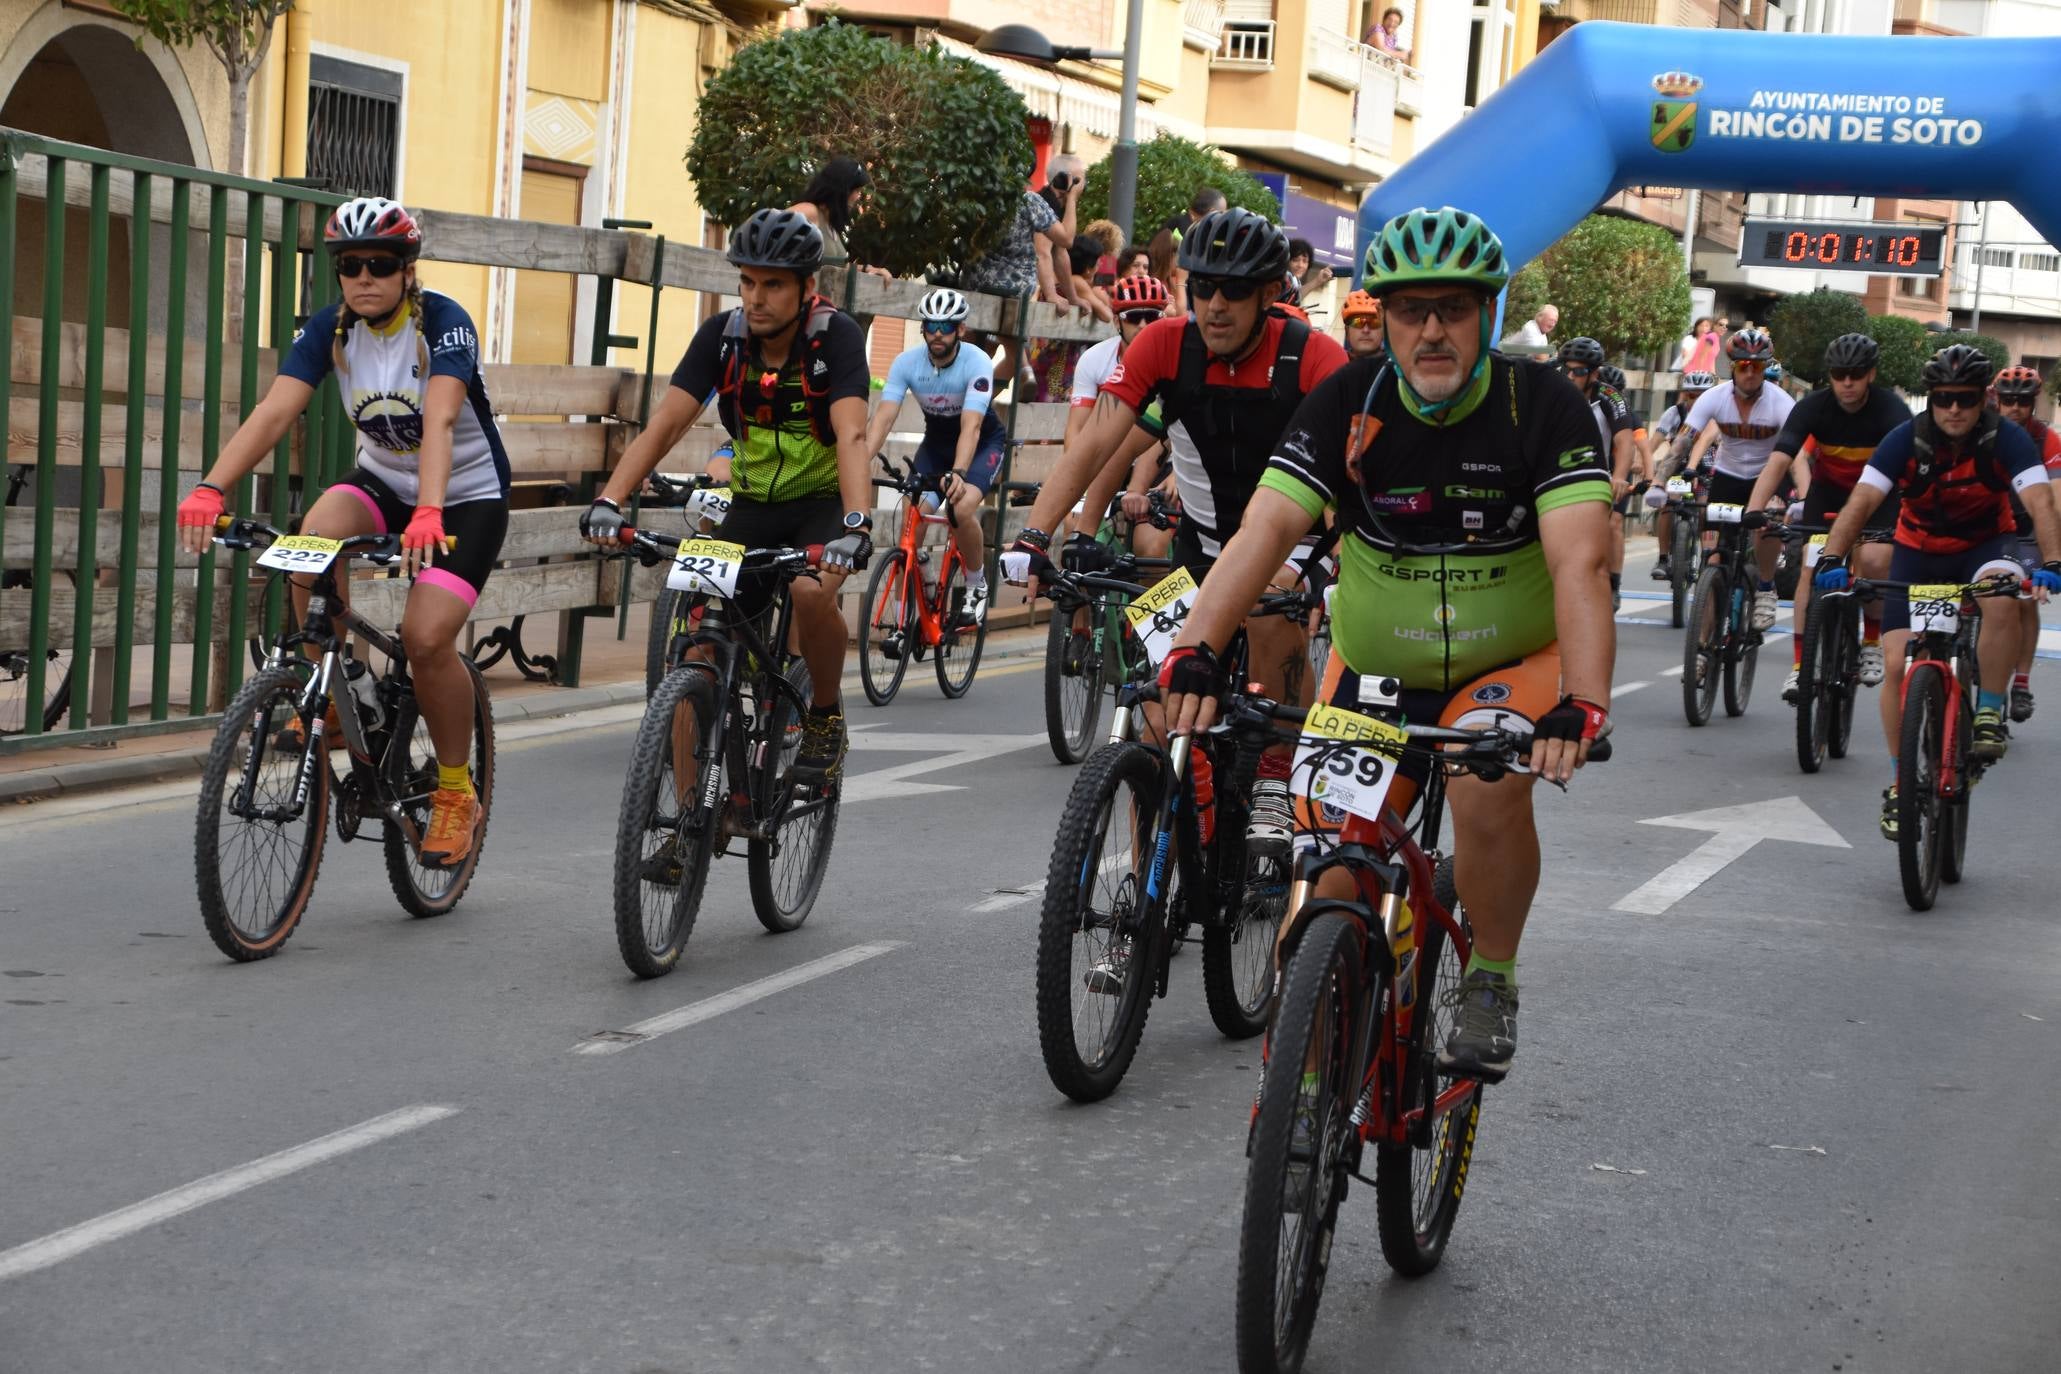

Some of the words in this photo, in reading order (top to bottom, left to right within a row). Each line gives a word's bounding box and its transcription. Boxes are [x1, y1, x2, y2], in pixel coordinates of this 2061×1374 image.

[1751, 91, 1911, 114] AYUNTAMIENTO
[1916, 97, 1944, 114] DE
[1840, 116, 1883, 142] DE
[1891, 118, 1983, 146] SOTO
[1785, 231, 1920, 266] 0:01:10
[697, 491, 731, 513] 129
[272, 548, 328, 563] 222
[277, 538, 297, 549] LA
[299, 539, 337, 551] PERA
[682, 543, 700, 553] LA
[703, 544, 740, 560] PERA
[679, 556, 731, 579] 221
[1378, 563, 1484, 582] GSPORT
[1131, 602, 1152, 621] LA
[1151, 576, 1190, 606] PERA
[1914, 601, 1956, 618] 258
[1153, 598, 1191, 633] 64
[1311, 711, 1340, 733] LA
[703, 764, 721, 809] ROCKSHOX
[1453, 1103, 1479, 1200] MAXXIS
